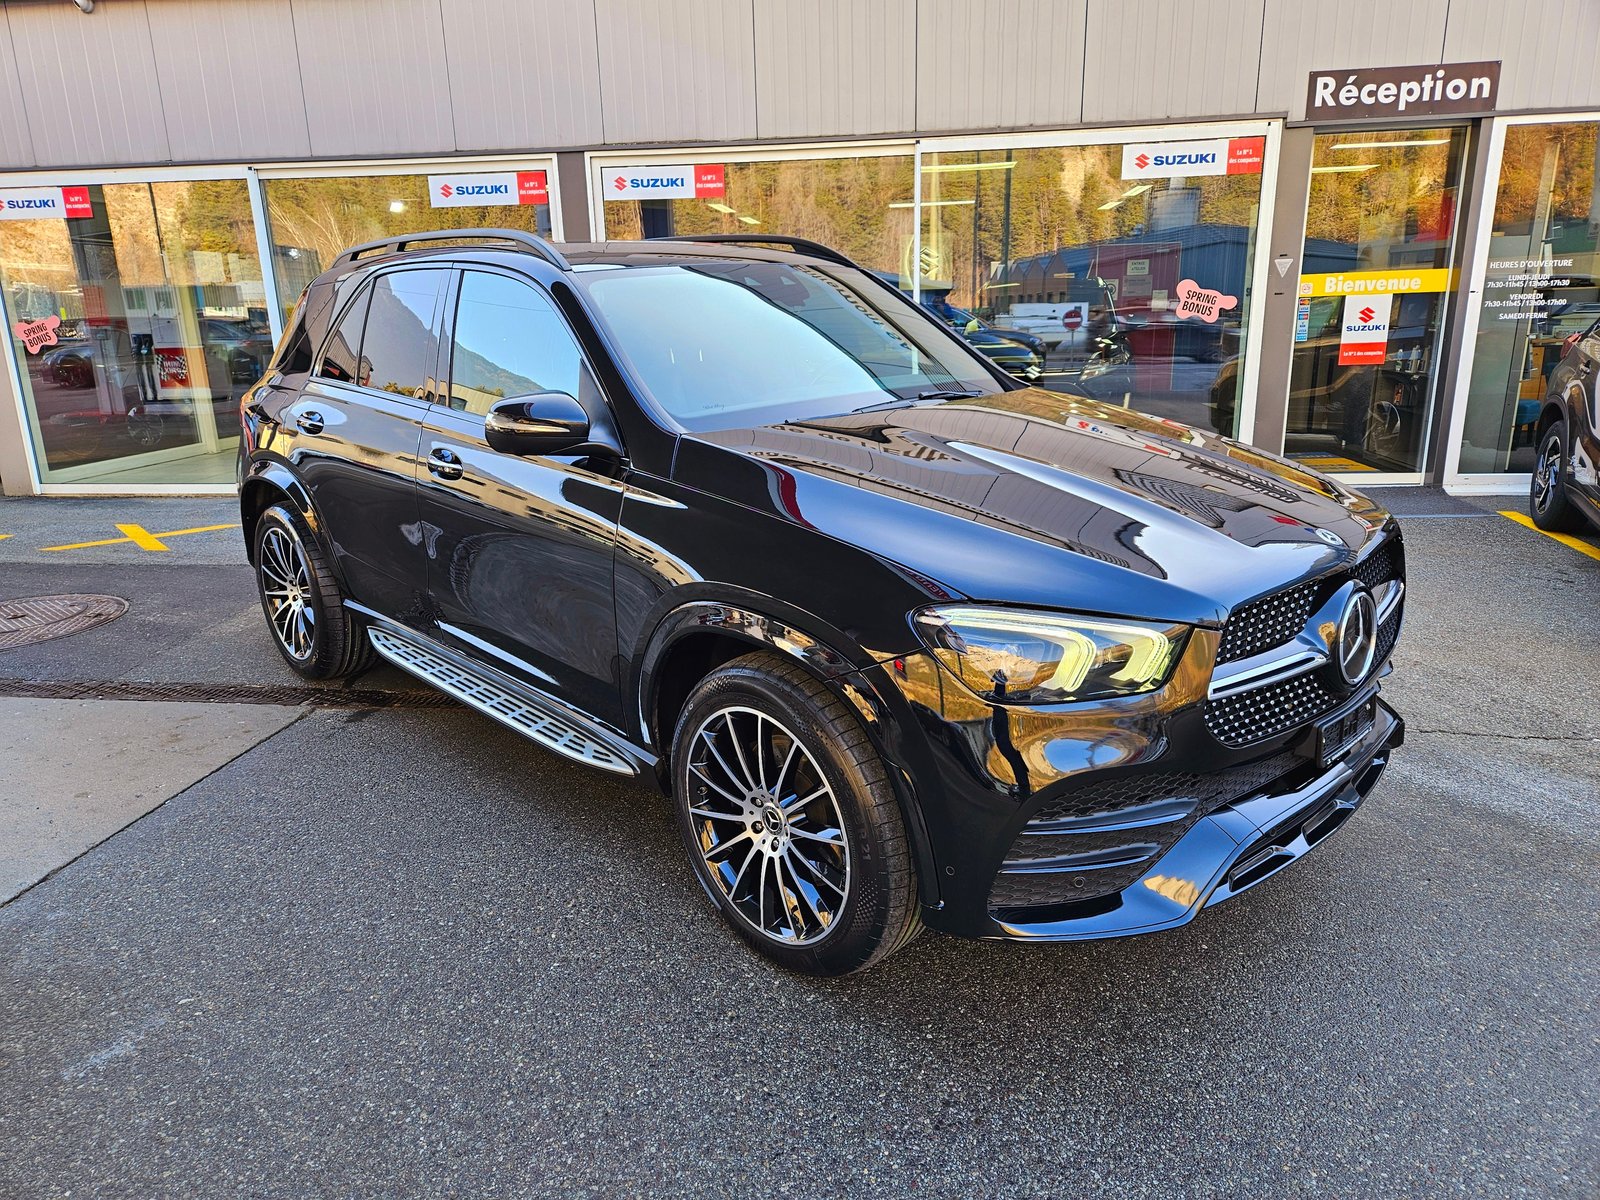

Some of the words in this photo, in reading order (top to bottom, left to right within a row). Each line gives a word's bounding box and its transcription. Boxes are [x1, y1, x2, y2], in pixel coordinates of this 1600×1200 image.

[1314, 69, 1491, 111] Réception
[1153, 153, 1216, 166] SUZUKI
[630, 177, 685, 188] SUZUKI
[455, 184, 508, 195] SUZUKI
[7, 199, 56, 209] SUZUKI
[1489, 261, 1519, 269] HEURES
[1520, 259, 1574, 268] D'OUVERTURE
[1508, 273, 1551, 281] LUNDI-JEUDI
[1324, 275, 1422, 293] Bienvenue
[1186, 290, 1217, 305] SPRING
[1182, 301, 1213, 316] BONUS
[1498, 312, 1525, 320] SAMEDI
[23, 323, 48, 338] SPRING
[1346, 324, 1386, 332] SUZUKI
[28, 332, 51, 347] BONUS
